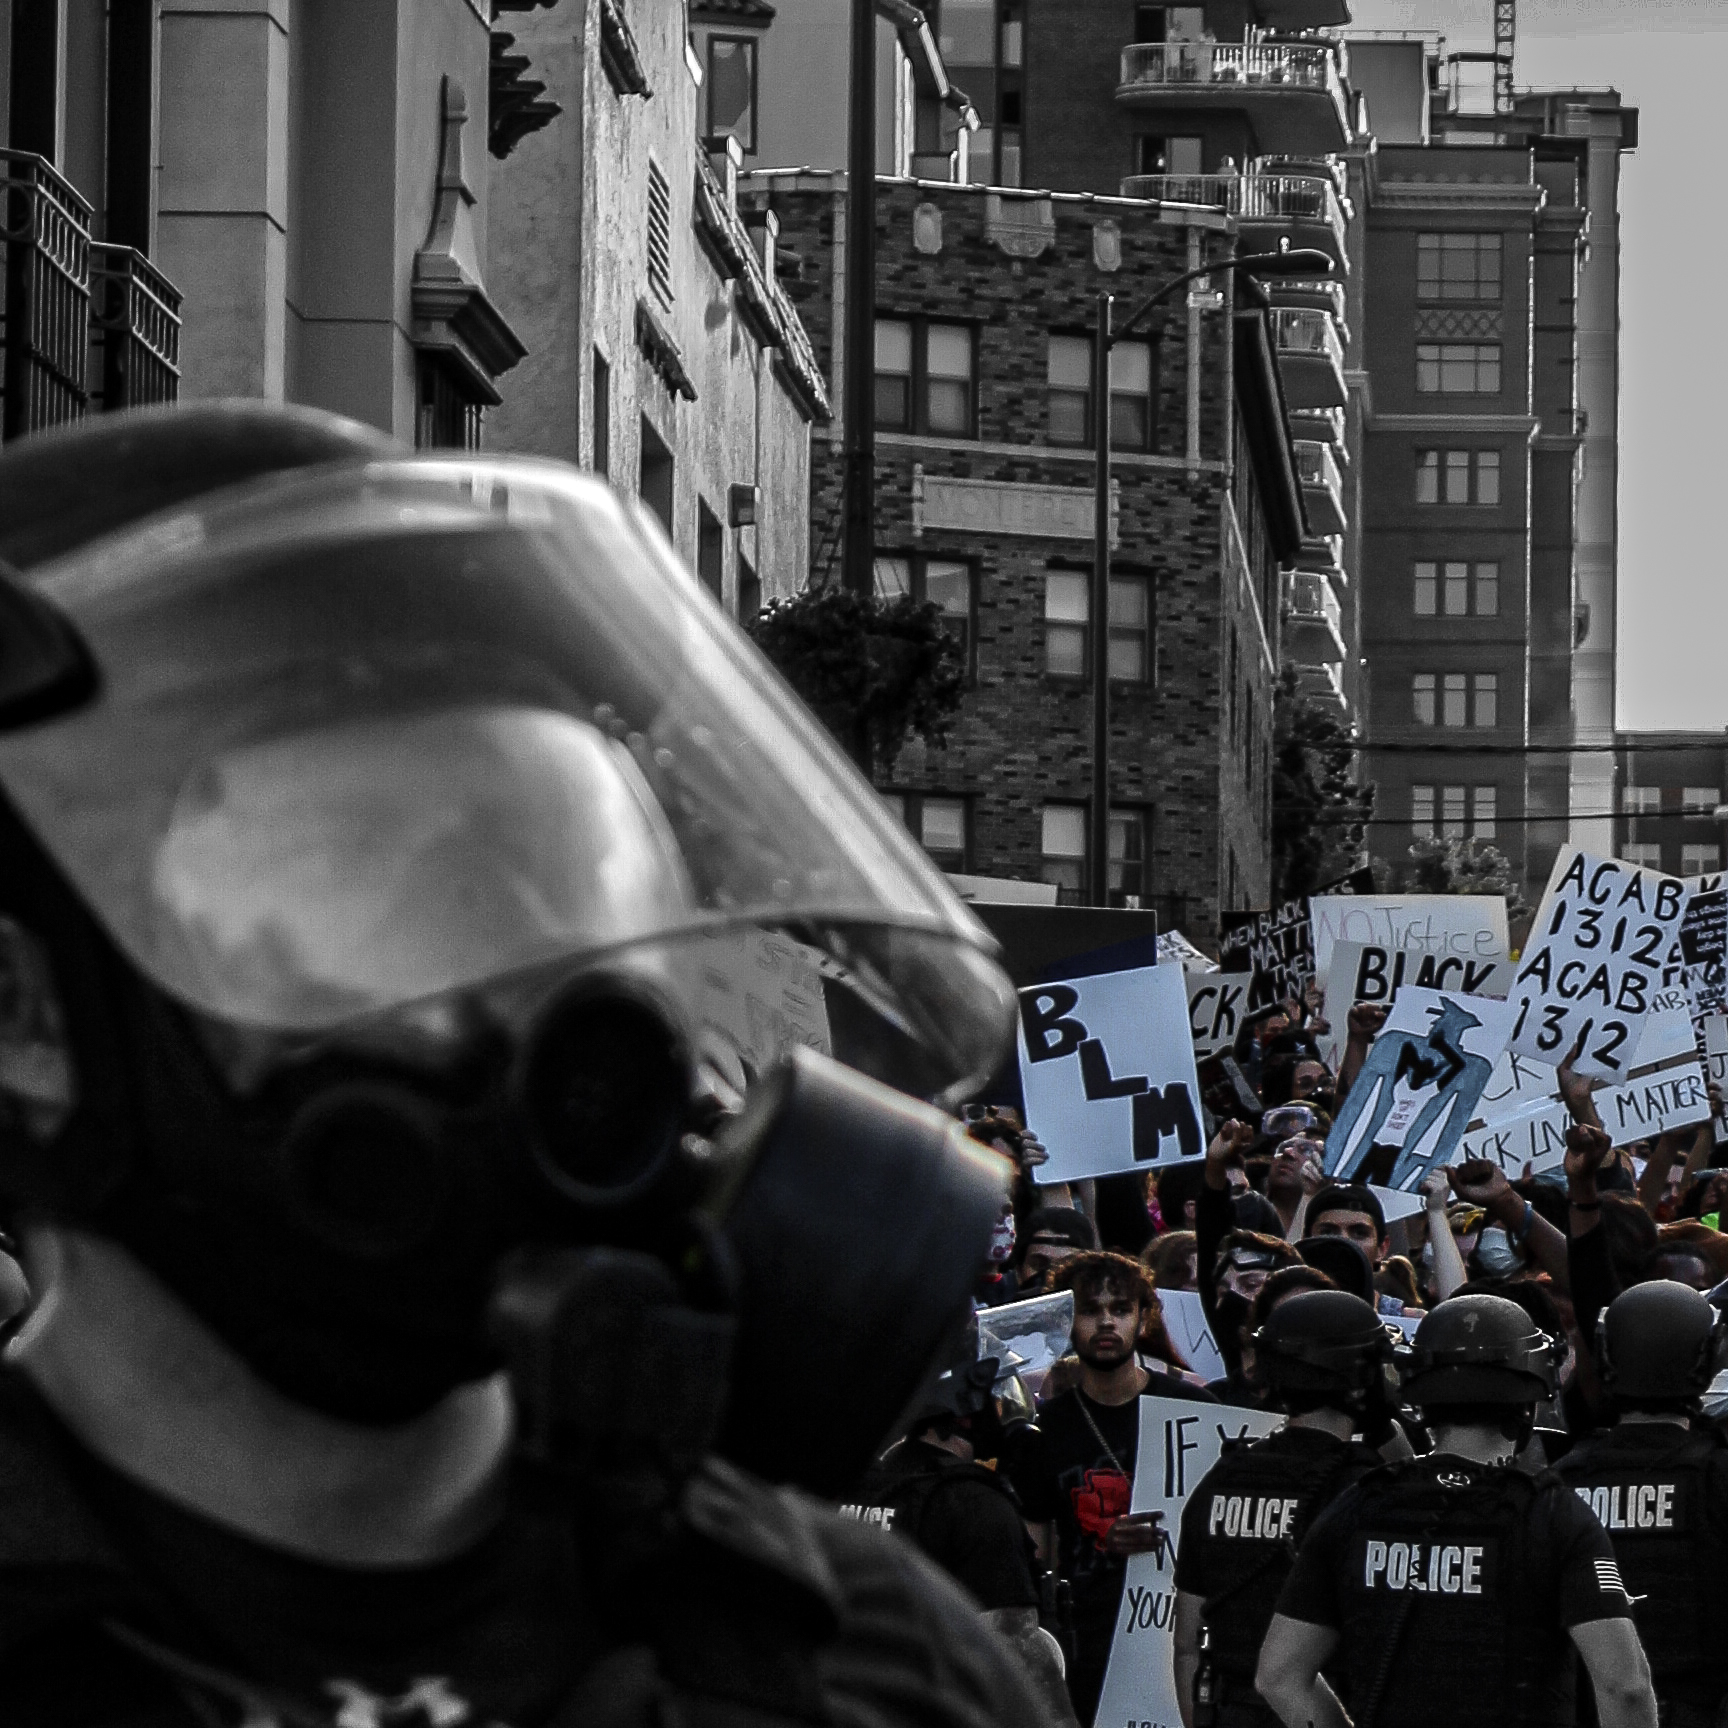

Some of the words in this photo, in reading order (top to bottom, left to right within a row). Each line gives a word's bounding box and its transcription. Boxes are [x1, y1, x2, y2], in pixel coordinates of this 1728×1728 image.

[1258, 896, 1306, 938] BLACK
[1555, 852, 1684, 922] ACAB
[1250, 919, 1314, 971] MATT
[1549, 899, 1663, 969] 1312
[1517, 946, 1649, 1014] ACAB
[1511, 996, 1629, 1071] 1312
[1020, 984, 1202, 1163] BLM
[1616, 1074, 1710, 1129] MATTER
[1164, 1416, 1200, 1499] IF
[1210, 1495, 1298, 1540] POLICE
[1366, 1540, 1484, 1595] POLICE
